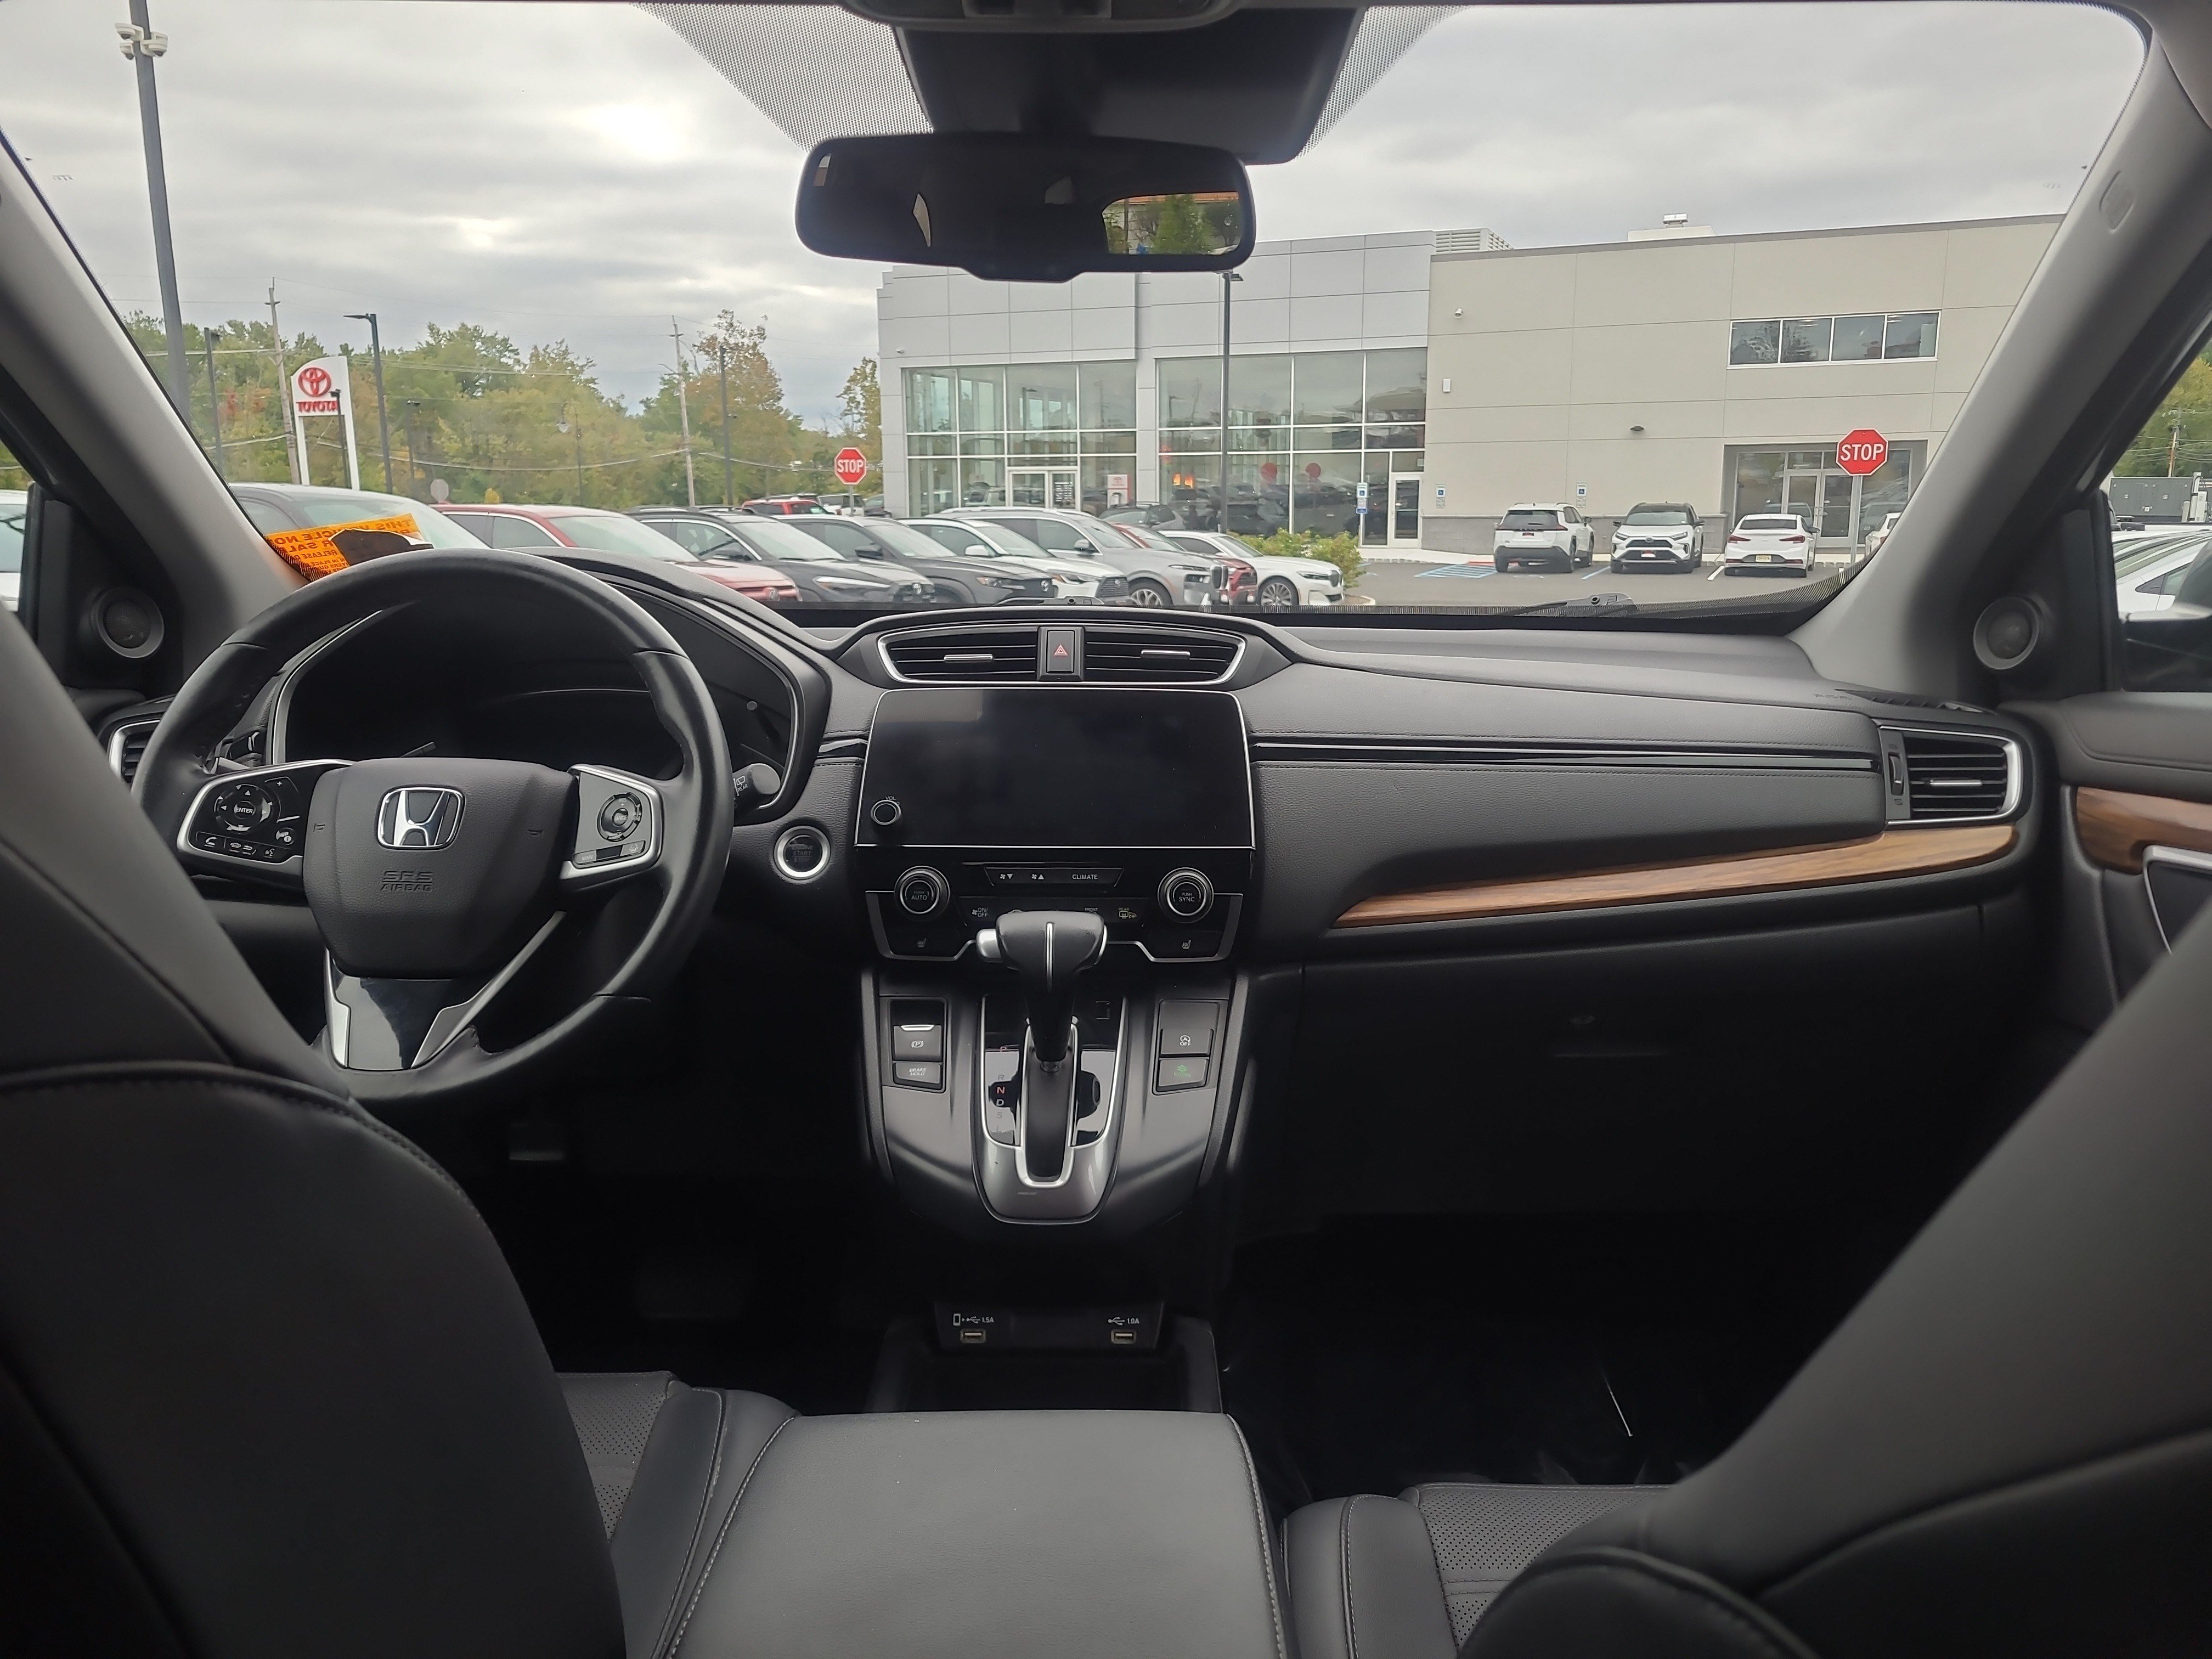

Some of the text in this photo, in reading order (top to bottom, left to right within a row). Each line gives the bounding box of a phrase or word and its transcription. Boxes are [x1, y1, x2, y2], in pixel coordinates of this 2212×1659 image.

[1840, 443, 1884, 461] STOP
[837, 459, 864, 473] STOP
[737, 784, 748, 792] REAR
